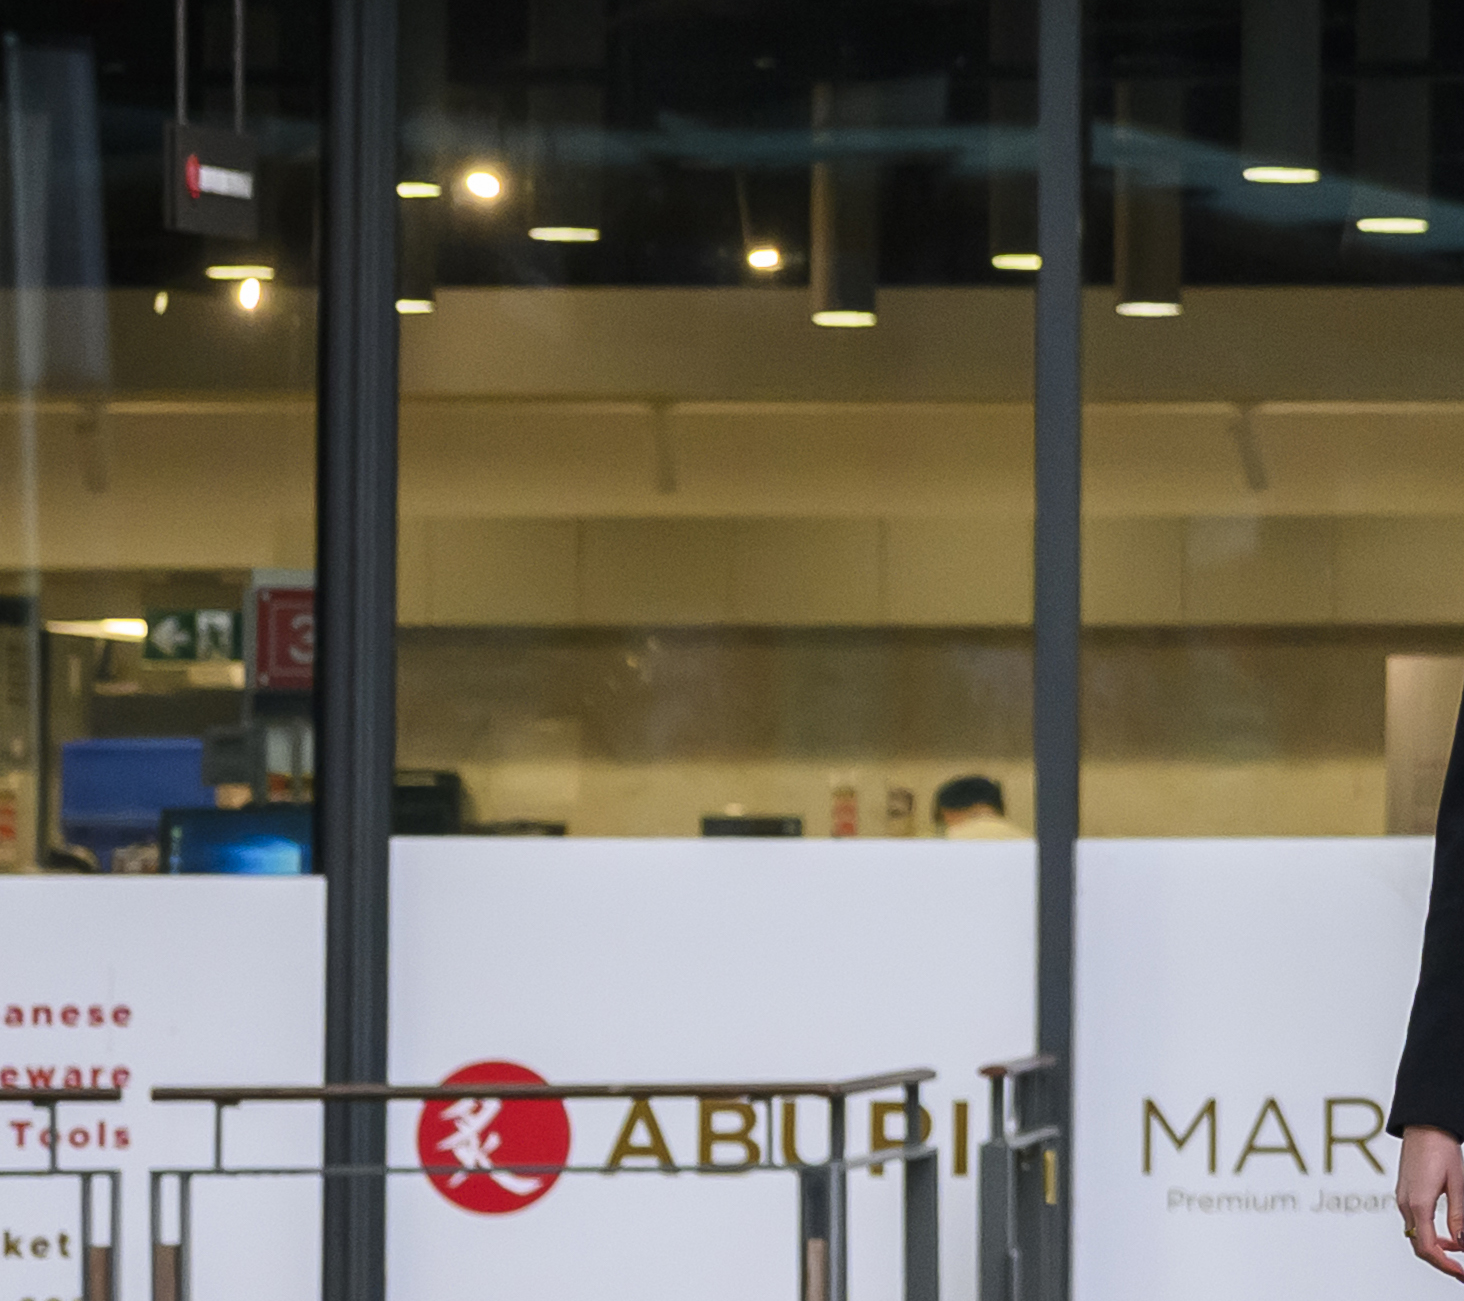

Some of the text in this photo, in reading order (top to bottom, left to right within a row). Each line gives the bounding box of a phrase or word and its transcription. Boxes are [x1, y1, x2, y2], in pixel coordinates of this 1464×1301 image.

[4, 1004, 132, 1028] anese
[0, 1066, 131, 1089] eware
[9, 1118, 131, 1150] Tools
[1165, 1188, 1298, 1214] Premium
[3, 1228, 72, 1259] ket
